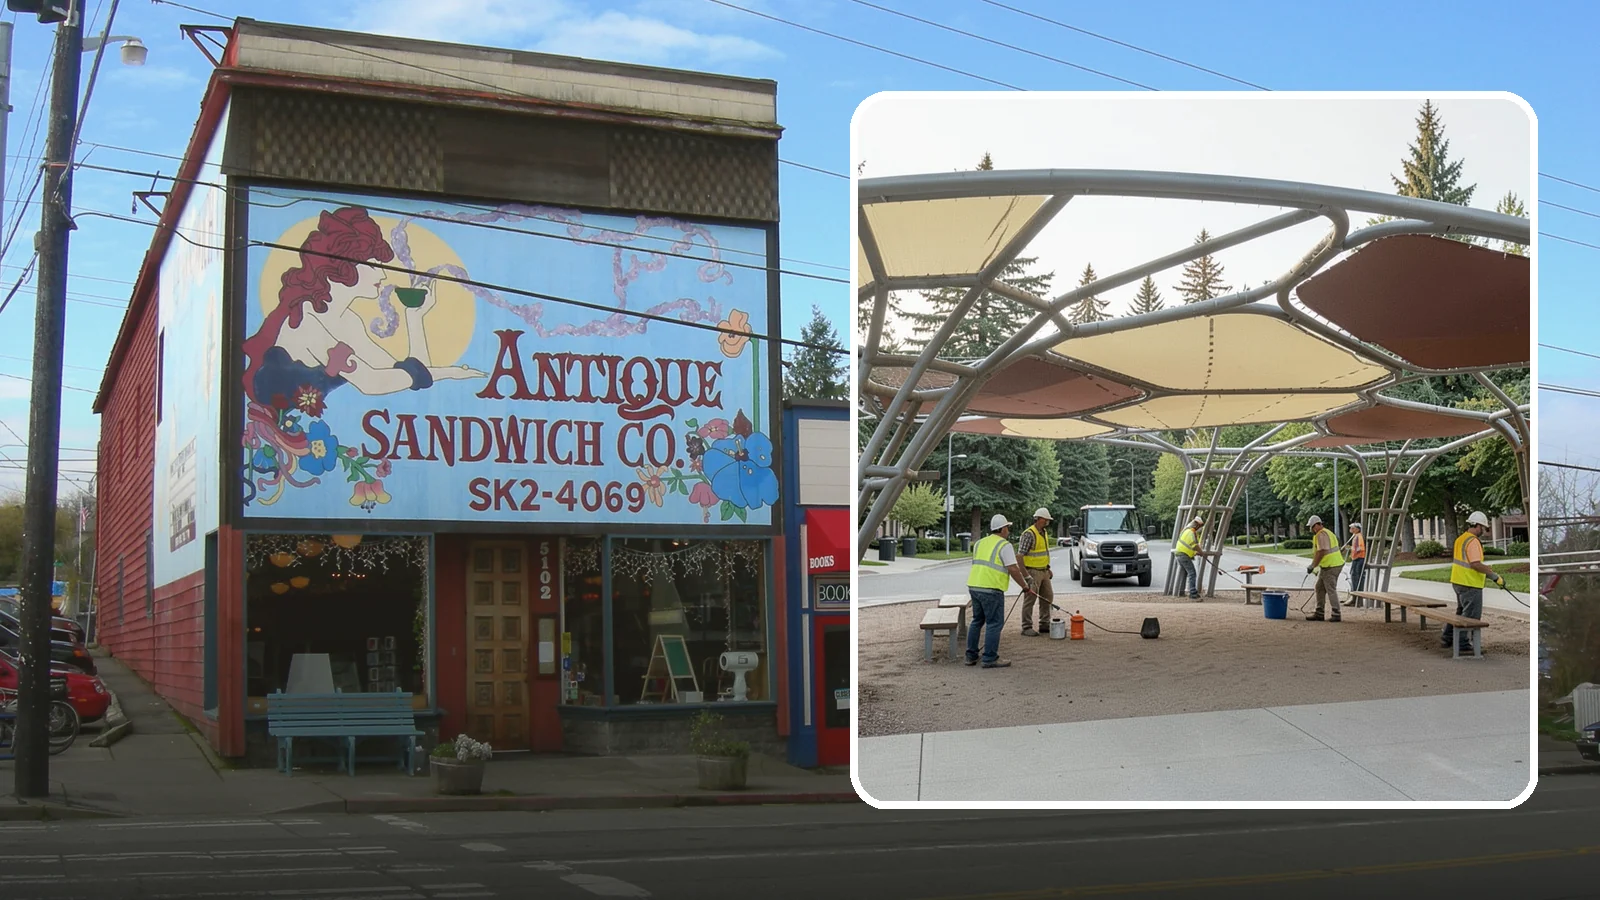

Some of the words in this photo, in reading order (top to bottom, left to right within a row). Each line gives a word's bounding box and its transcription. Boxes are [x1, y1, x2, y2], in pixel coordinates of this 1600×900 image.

[476, 329, 723, 421] ANTIQUE
[361, 408, 604, 467] SANDWICH
[617, 422, 684, 468] CO.
[468, 478, 645, 513] SK2-4069
[540, 542, 551, 600] 5102
[809, 555, 834, 569] BOOKS
